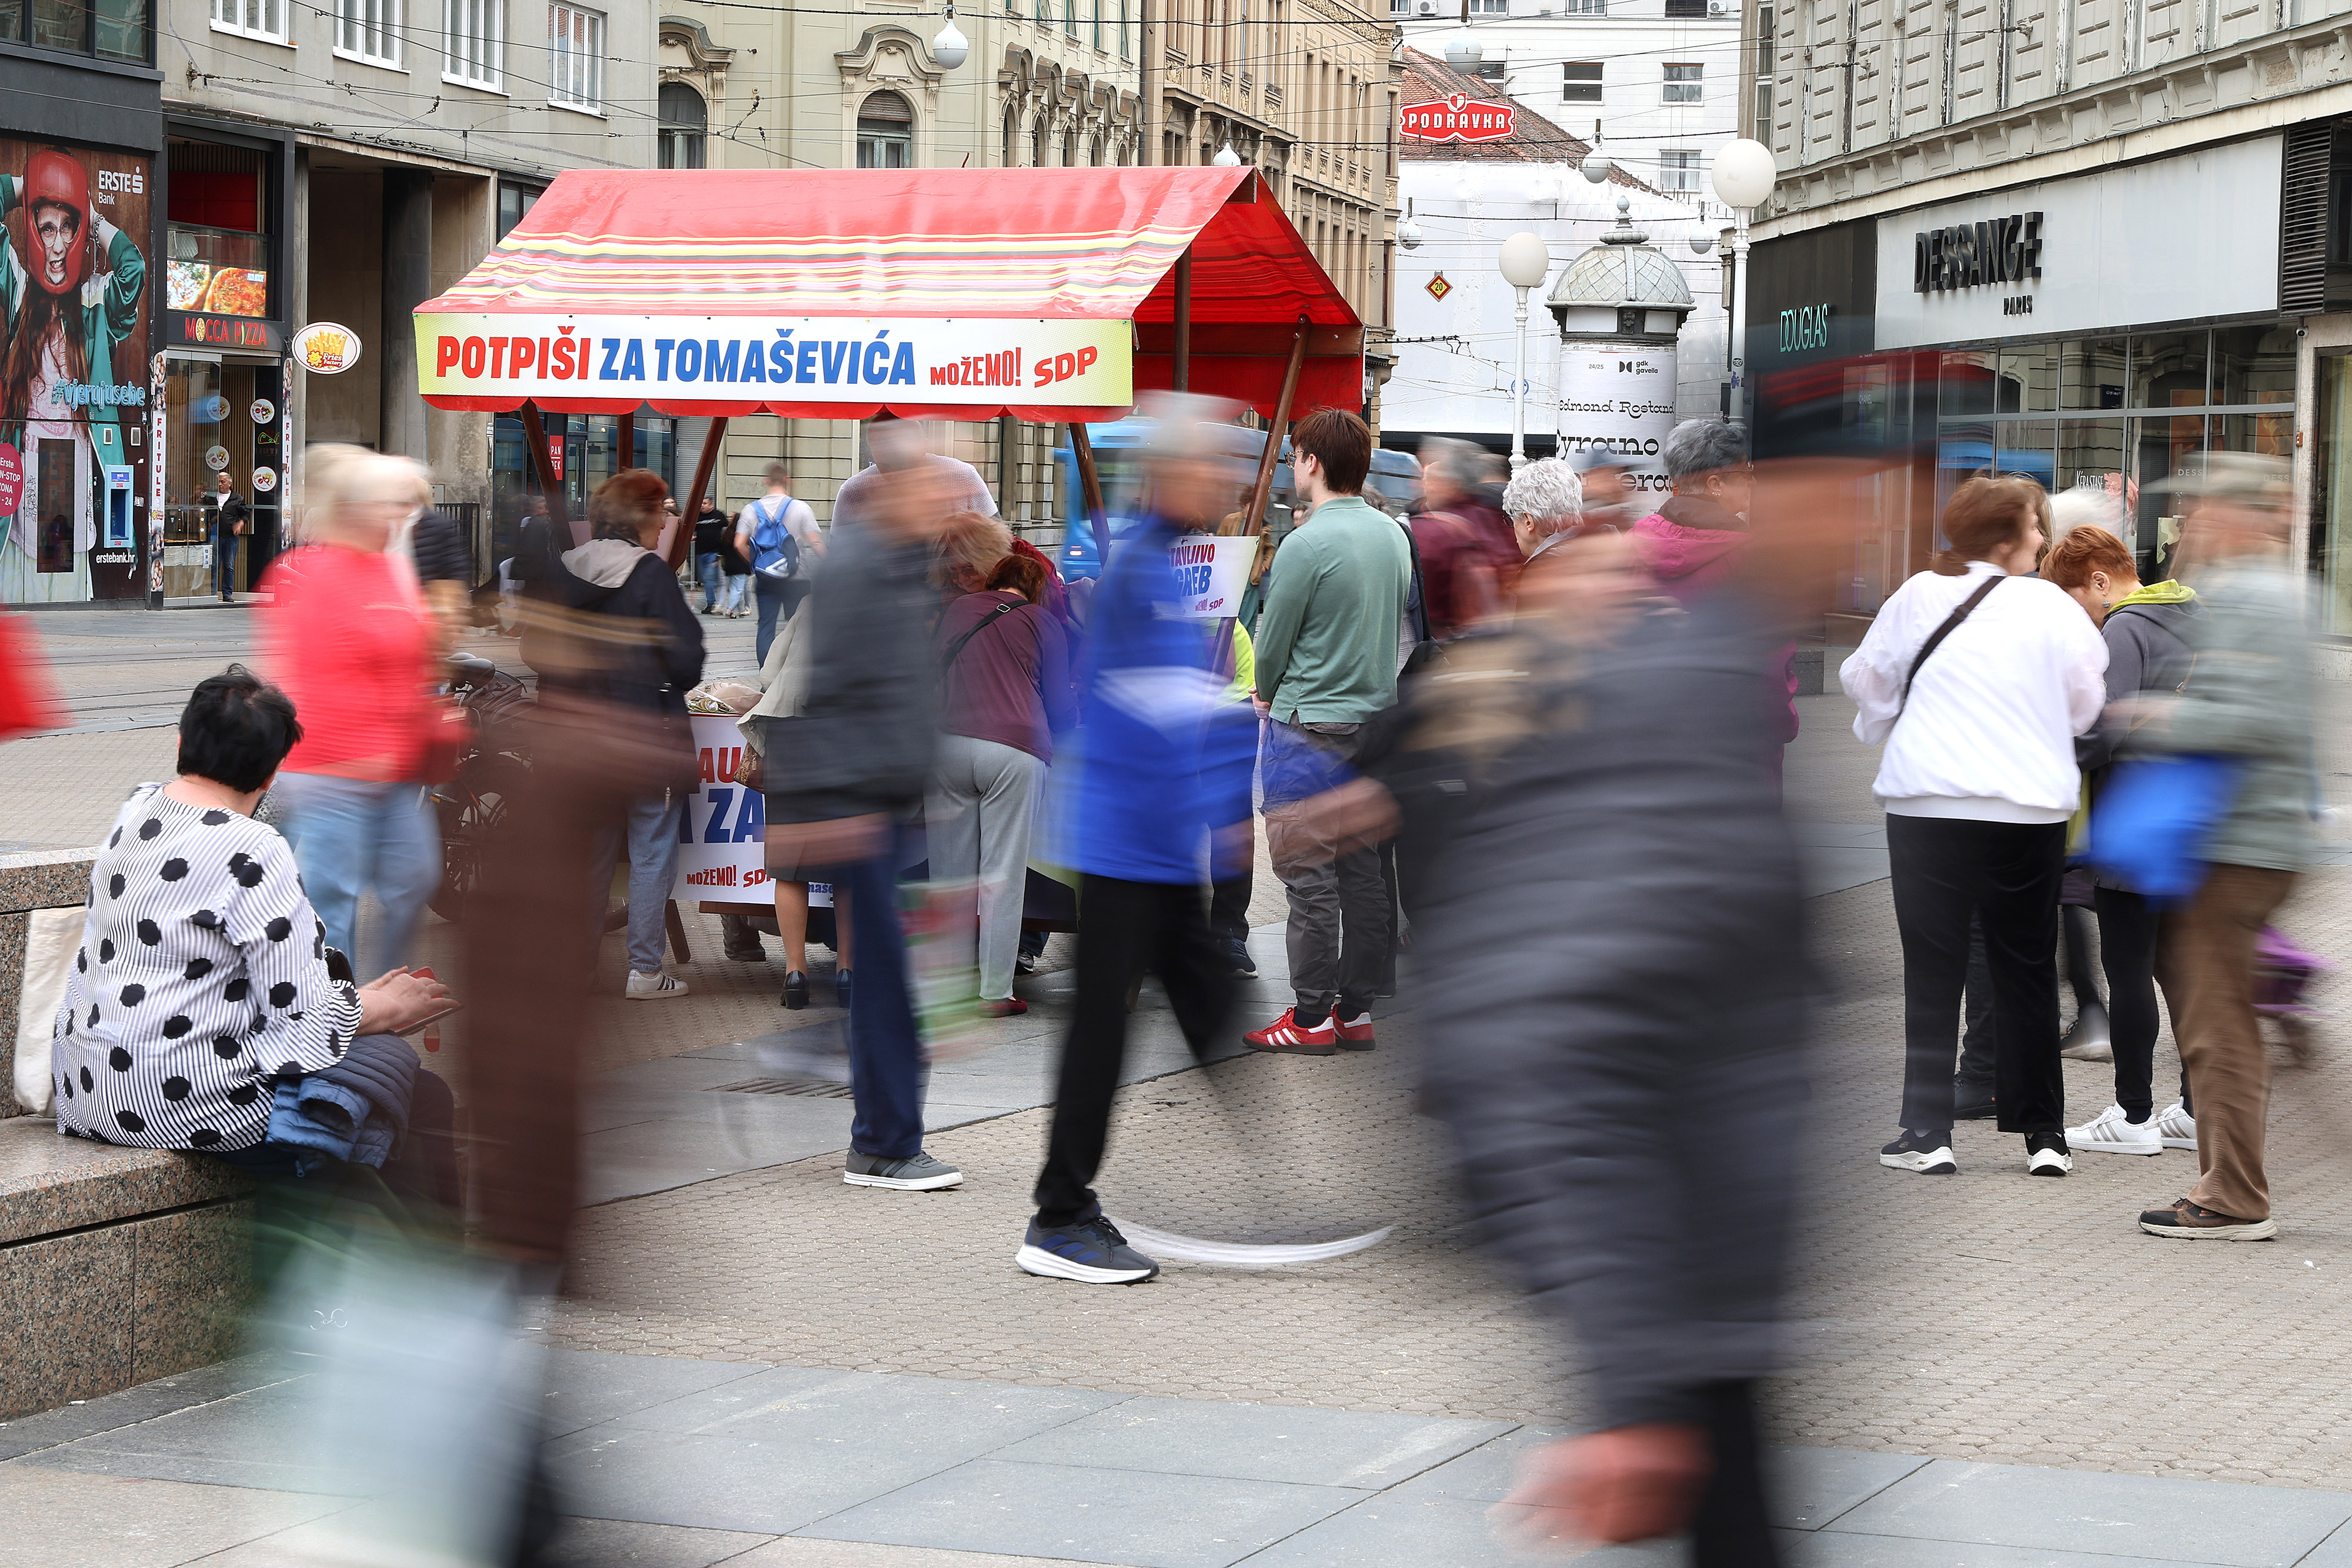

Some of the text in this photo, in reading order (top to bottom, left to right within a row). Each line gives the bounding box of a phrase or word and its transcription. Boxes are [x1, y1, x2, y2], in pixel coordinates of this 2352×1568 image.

[1408, 112, 1505, 129] PODRAVKA
[99, 170, 131, 193] ERSTE
[99, 192, 115, 205] Bank
[1914, 211, 2044, 293] DESSANGE
[1435, 282, 1443, 291] 20
[2003, 295, 2033, 316] PARIS
[185, 317, 267, 346] MOCCA PIZZA
[1780, 303, 1828, 352] DOUGLAS
[323, 352, 342, 361] Fries
[437, 325, 1098, 388] POTPIŠI ZA TOMAŠEVIĆA MOŽEMO! SDP
[52, 378, 146, 412] #vjerujusebe
[1559, 398, 1674, 419] Edmond Rostand
[550, 446, 561, 455] PAN
[0, 457, 14, 469] Erste
[0, 482, 13, 494] ONA
[2076, 470, 2104, 493] KÉRASTASE
[96, 551, 135, 564] erstebank.hr
[1169, 543, 1215, 567] TAVLJIVO
[1209, 597, 1224, 611] SDP
[687, 864, 771, 888] MOŽEMO! SD
